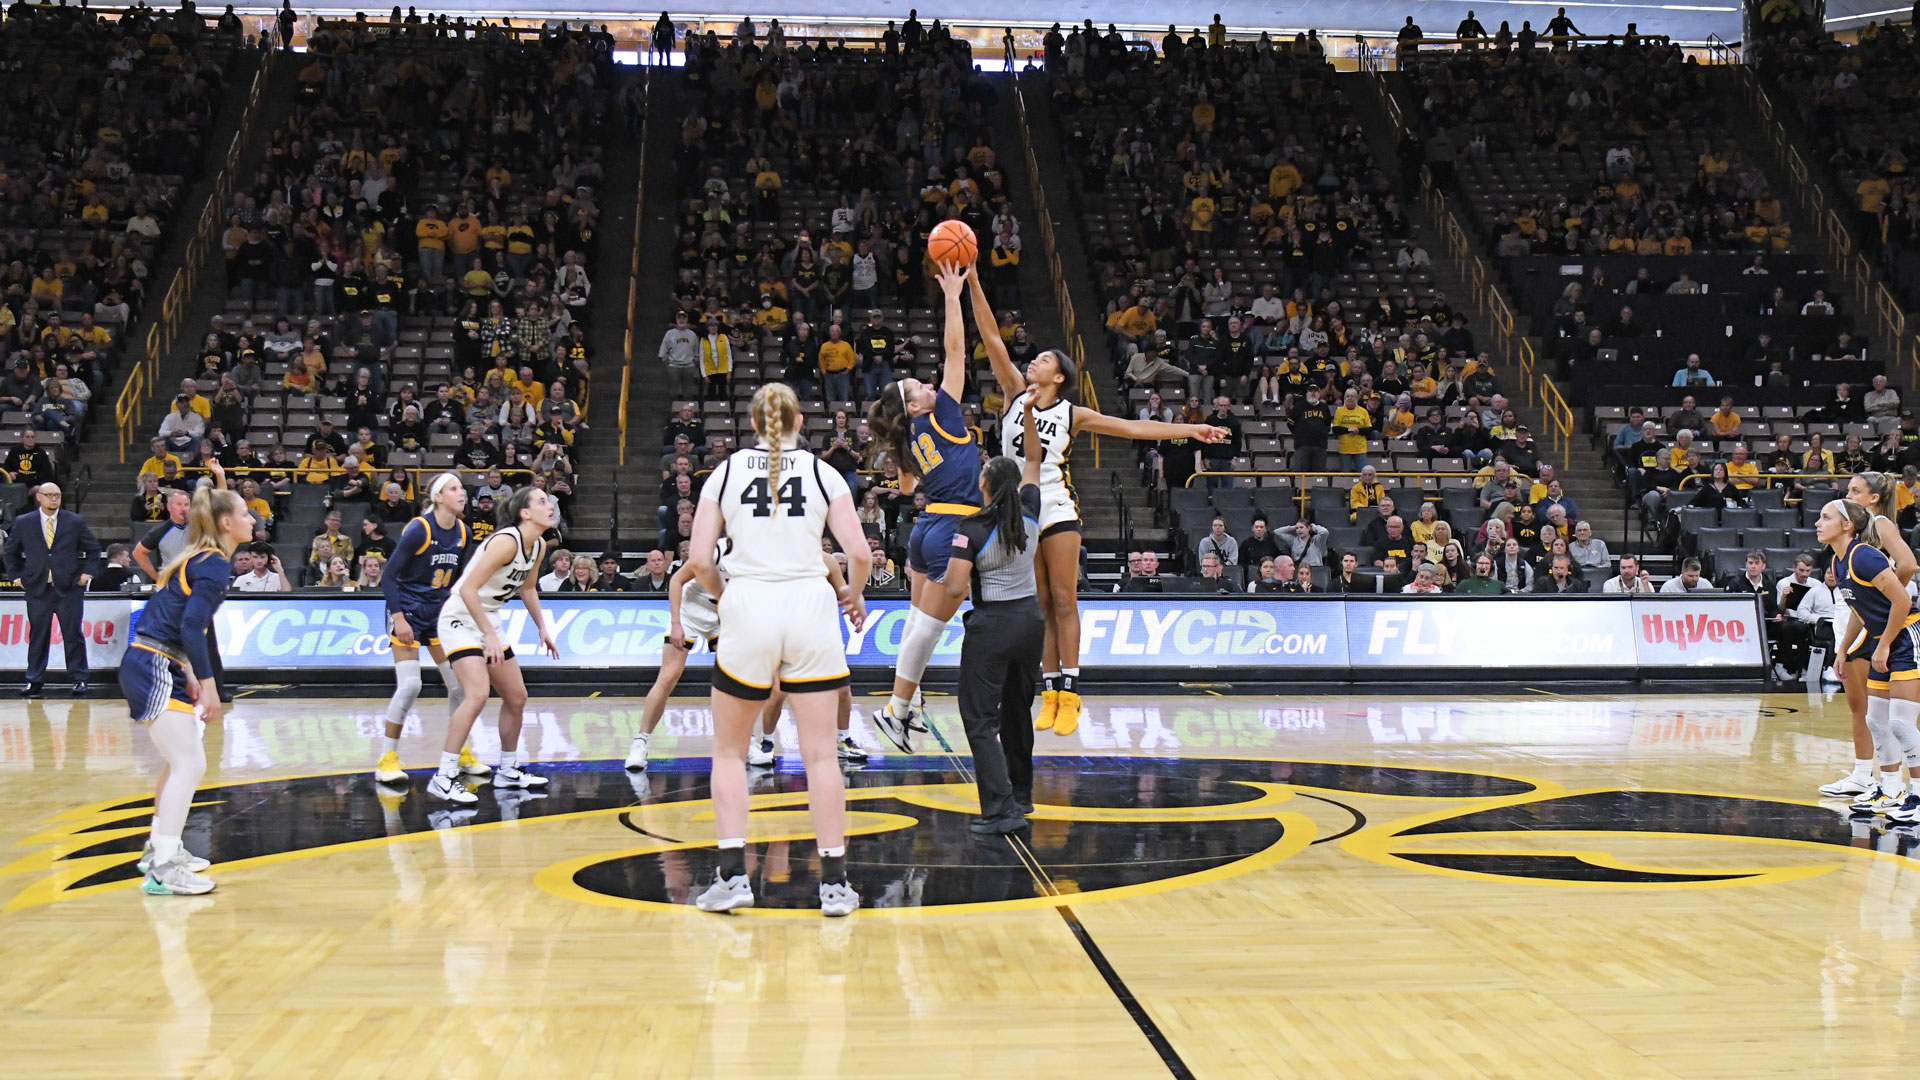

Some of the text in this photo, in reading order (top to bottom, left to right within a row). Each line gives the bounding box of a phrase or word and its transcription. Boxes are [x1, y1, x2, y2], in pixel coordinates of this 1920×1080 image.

[1308, 332, 1325, 340] IOWA
[1304, 410, 1324, 420] IOWA
[911, 431, 944, 475] 12
[747, 455, 797, 471] O'GDY
[740, 476, 807, 517] 44
[472, 522, 495, 531] IOWA
[431, 553, 459, 566] PRIDE
[493, 583, 518, 603] 2
[1641, 613, 1745, 651] HyVee
